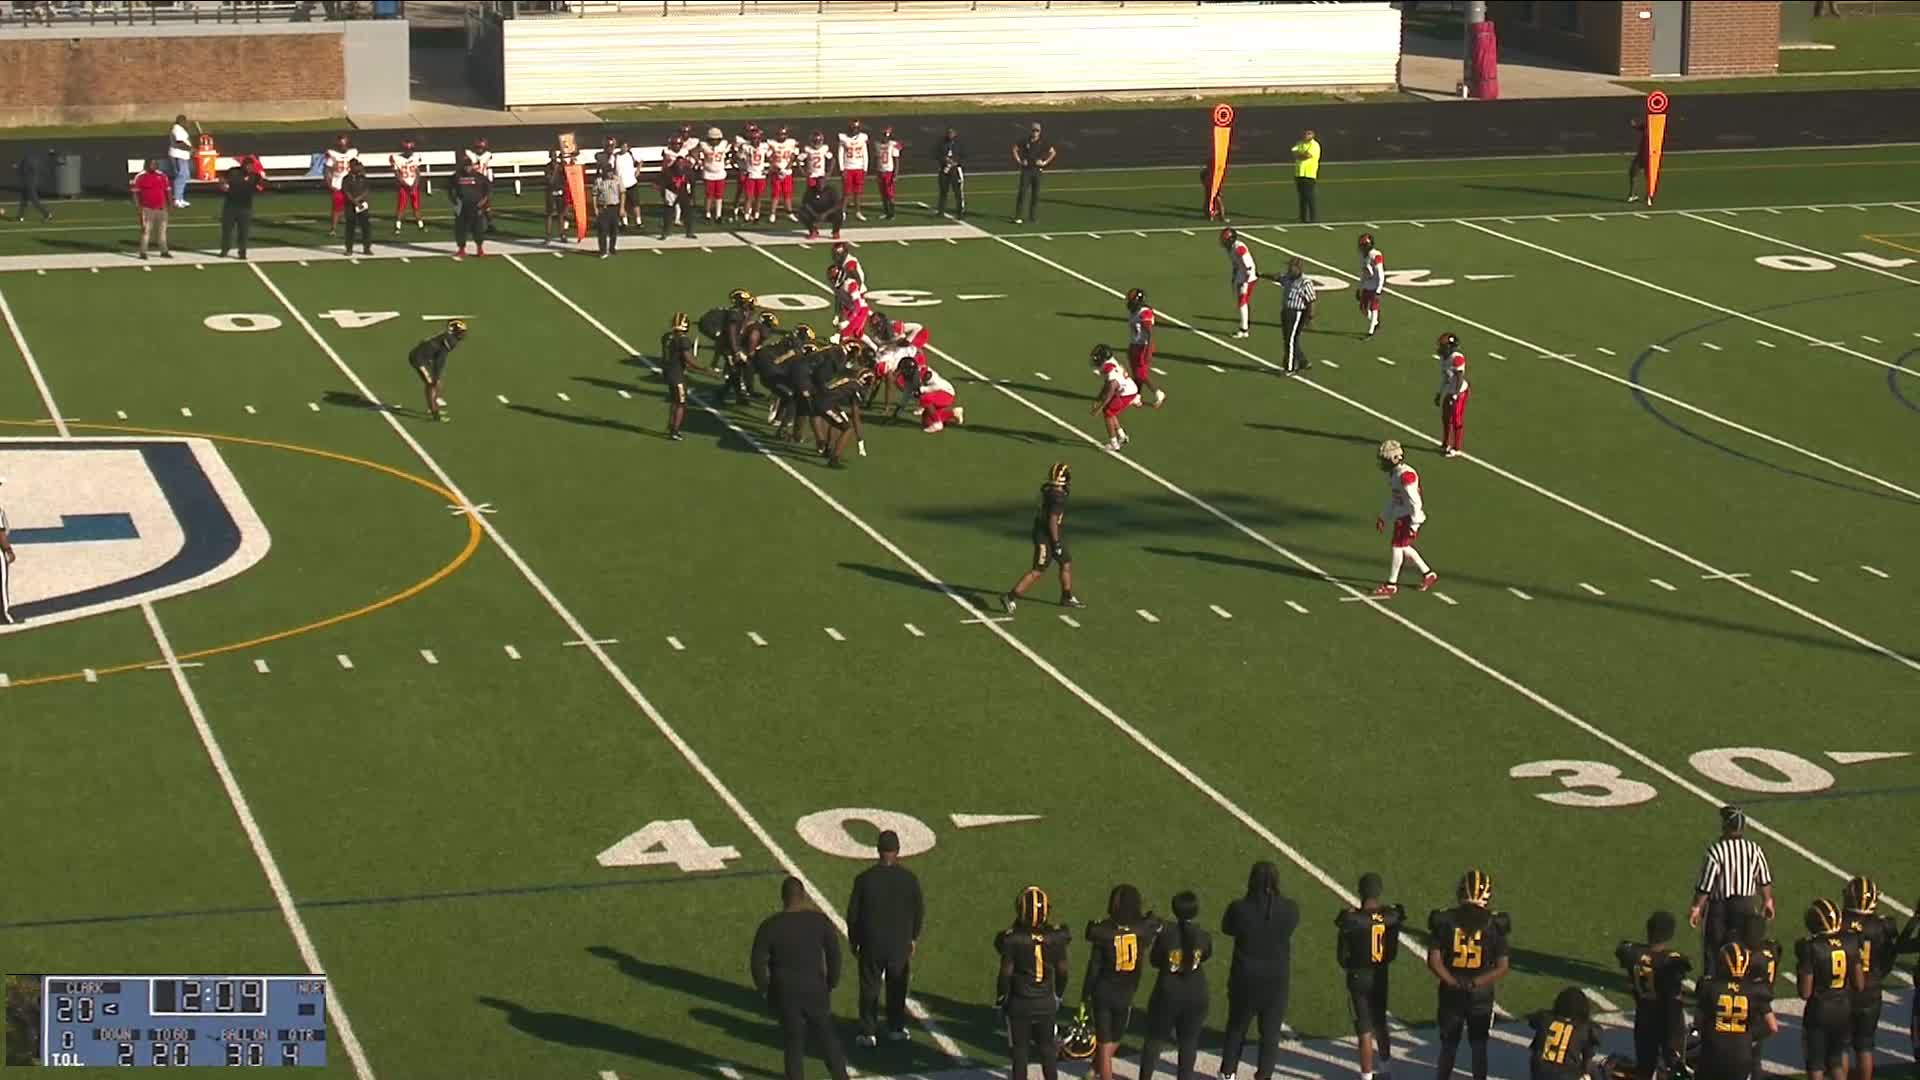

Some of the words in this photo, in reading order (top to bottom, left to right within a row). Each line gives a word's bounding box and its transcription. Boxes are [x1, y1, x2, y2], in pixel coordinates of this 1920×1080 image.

[1754, 253, 1917, 271] 10
[203, 309, 400, 331] 40
[1509, 747, 1836, 808] 30
[596, 807, 936, 872] 40
[1034, 943, 1044, 983] 1
[1113, 933, 1138, 972] 10
[1830, 949, 1847, 989] 9
[1715, 994, 1748, 1032] 22
[1542, 1020, 1574, 1064] 21
